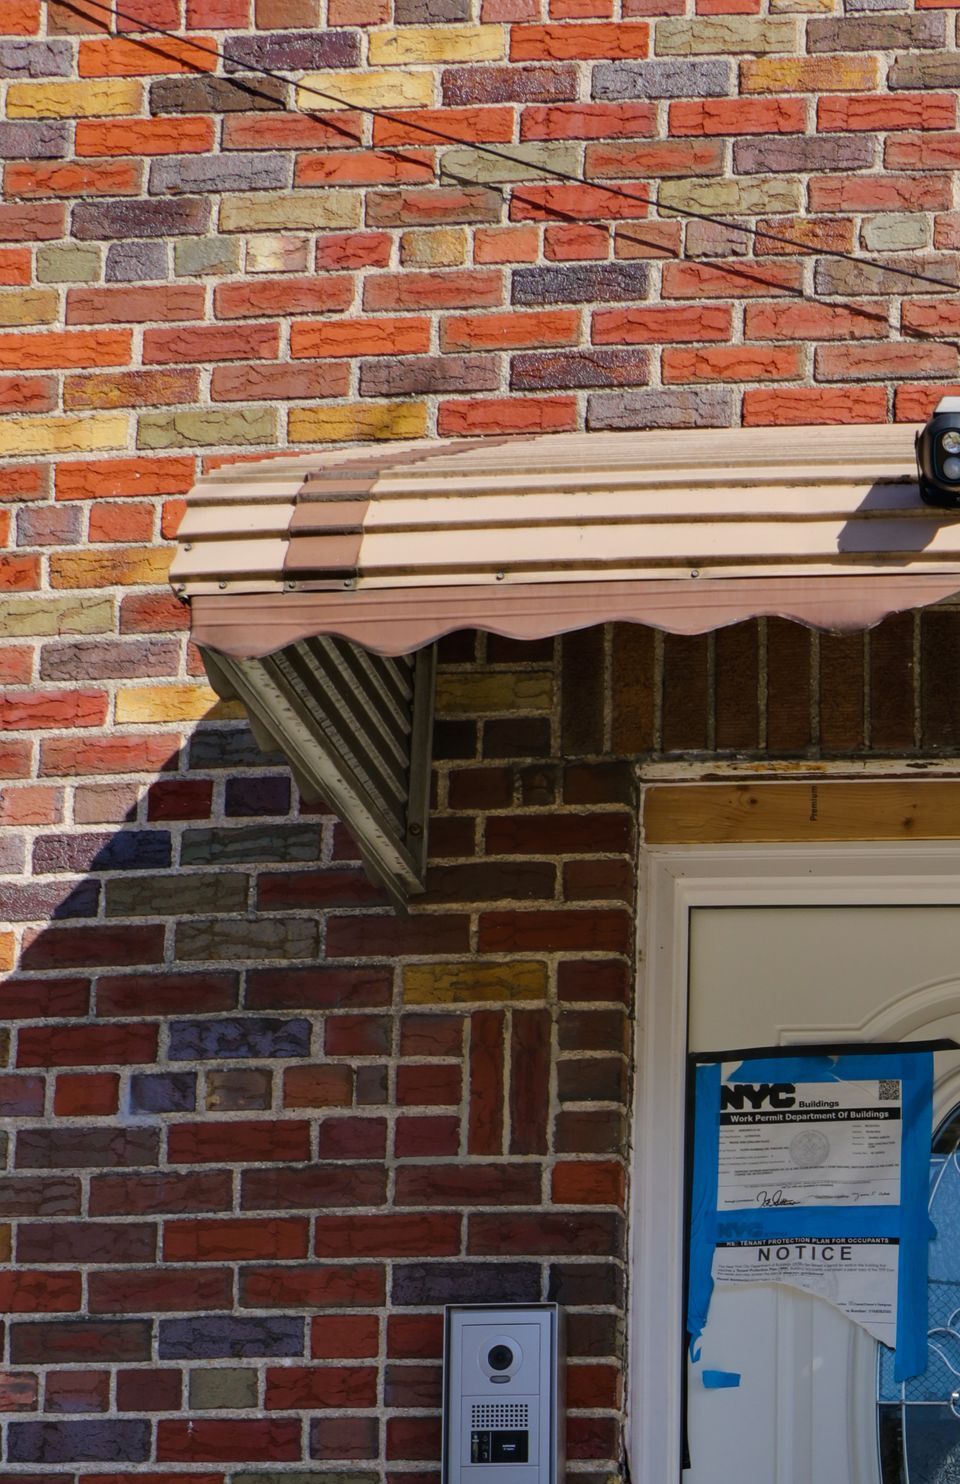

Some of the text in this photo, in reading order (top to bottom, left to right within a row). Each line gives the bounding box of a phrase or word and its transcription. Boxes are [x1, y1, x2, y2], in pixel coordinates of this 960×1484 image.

[809, 785, 818, 821] Premium
[720, 1084, 840, 1110] NYC Buildings
[785, 1111, 836, 1121] Department
[838, 1111, 848, 1119] Of
[850, 1110, 889, 1119] Buildings
[768, 1237, 811, 1245] PROTECTION
[758, 1245, 852, 1262] NOTICE
